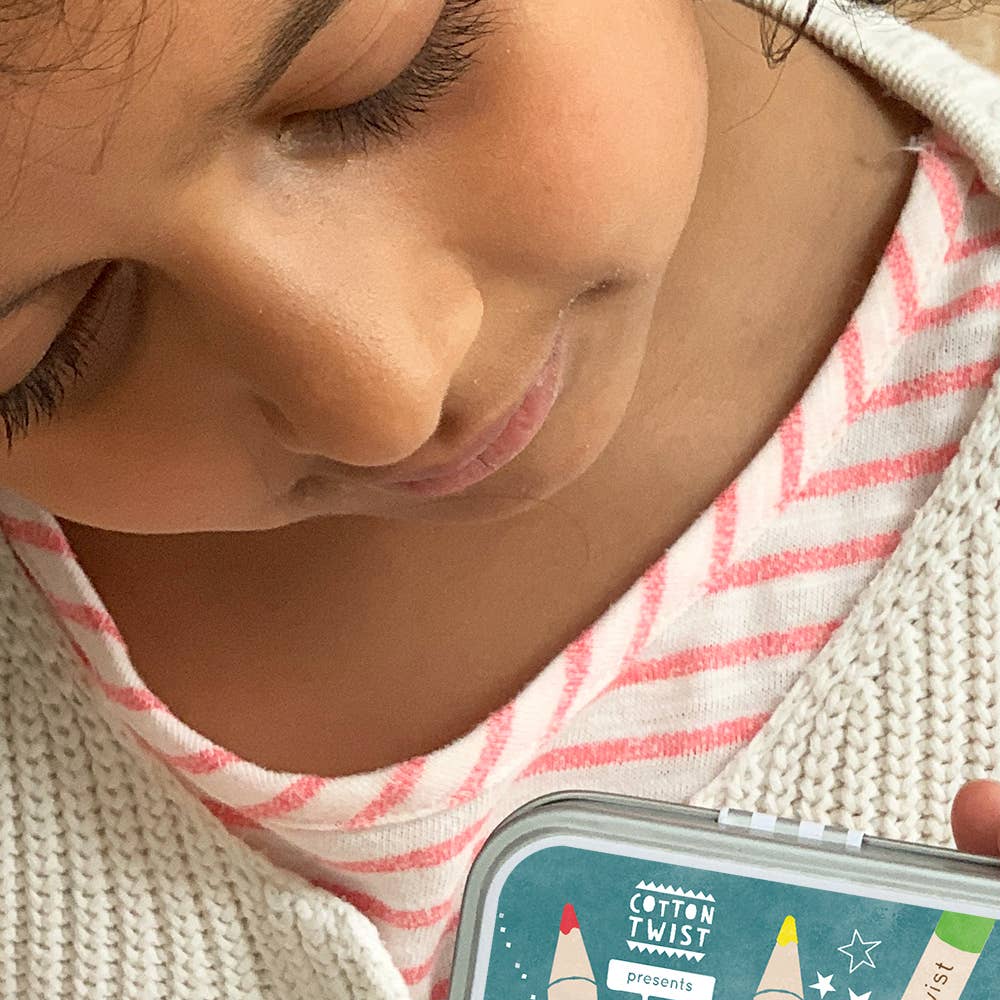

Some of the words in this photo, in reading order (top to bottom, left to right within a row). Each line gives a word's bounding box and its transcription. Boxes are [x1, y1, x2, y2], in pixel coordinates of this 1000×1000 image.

[629, 892, 715, 925] COTTON
[628, 915, 711, 947] TWIST
[626, 972, 693, 992] presents
